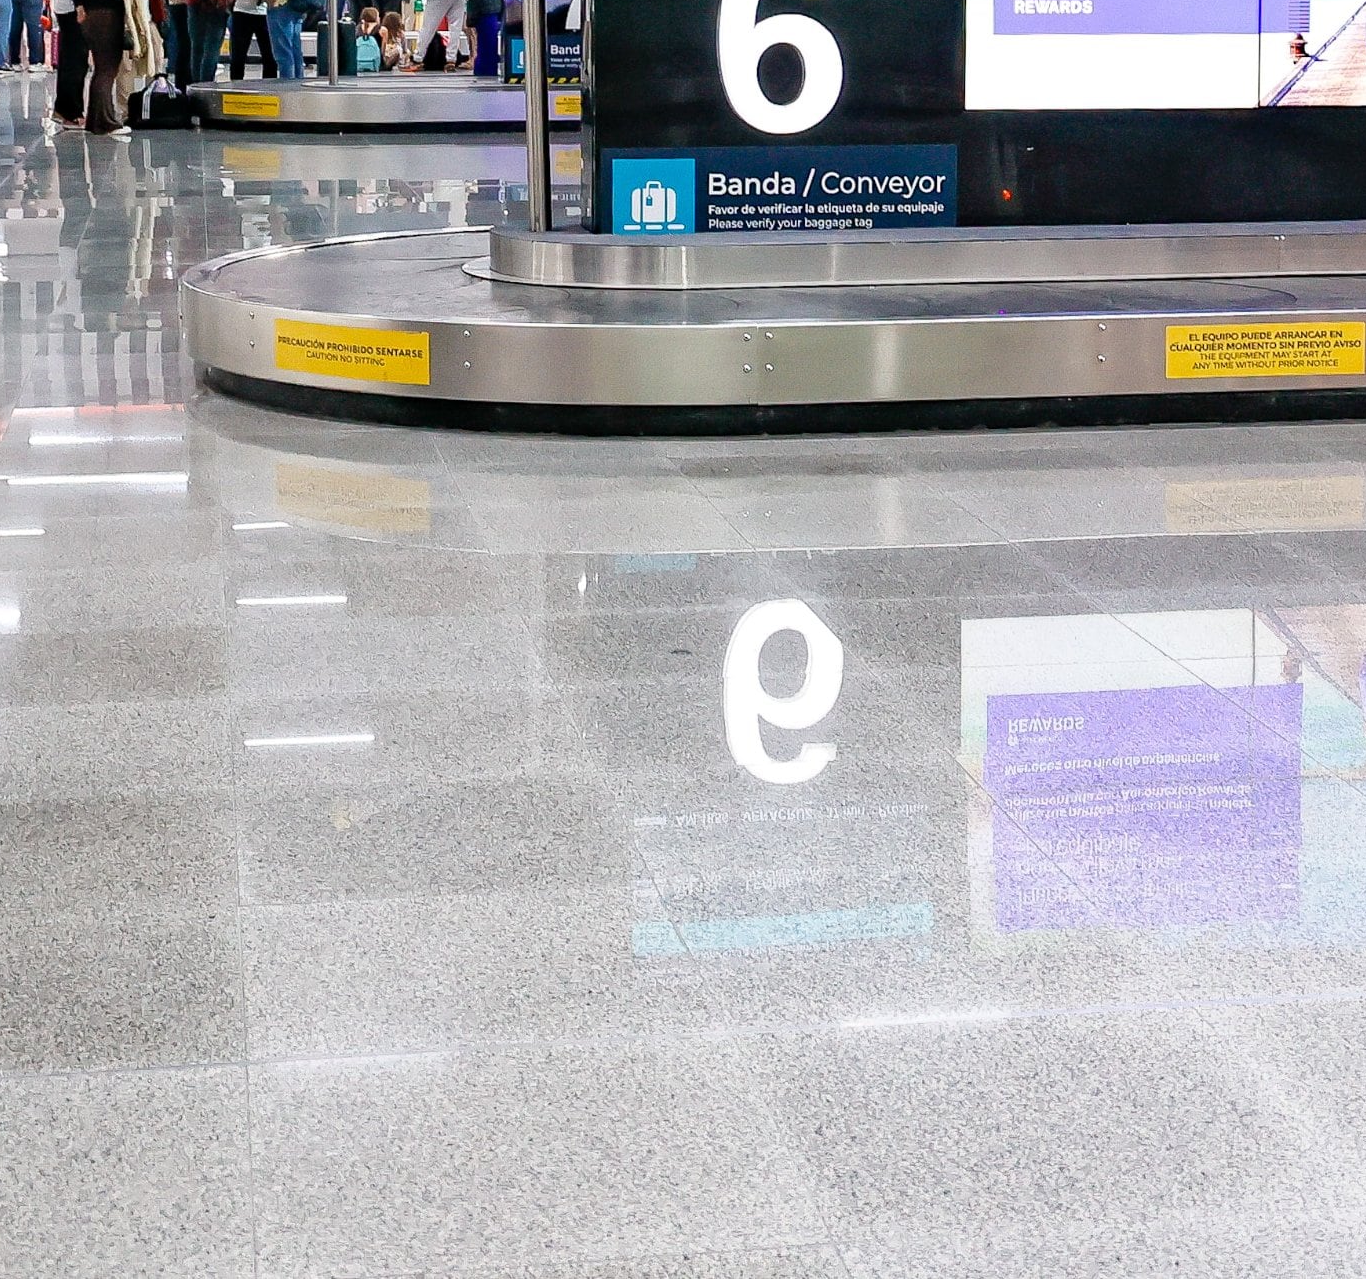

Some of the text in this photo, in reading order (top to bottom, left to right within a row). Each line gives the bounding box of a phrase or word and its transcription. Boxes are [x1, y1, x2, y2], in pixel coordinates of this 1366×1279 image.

[1014, 0, 1094, 14] REWARDS
[708, 168, 947, 199] Banda / Conveyor
[709, 201, 944, 216] Favor de verificar la etiqueta de su equipaje
[709, 217, 873, 231] Please verify your baggage tag
[1189, 330, 1343, 342] EL EQUIPO PUEDE ARRANCAR EN
[278, 335, 423, 359] PRECAUCIÓN PROHIBIDO SENTARSE
[1169, 340, 1361, 352] CUALQUIER MOMENTO SIN PREVIO AVISO
[306, 350, 386, 367] CAUTION NO SITTING
[1200, 350, 1333, 361] THE EQUIPMENT MAY START AT
[1192, 358, 1339, 370] ANY TIME WITHOUT PRIOR NOTICE
